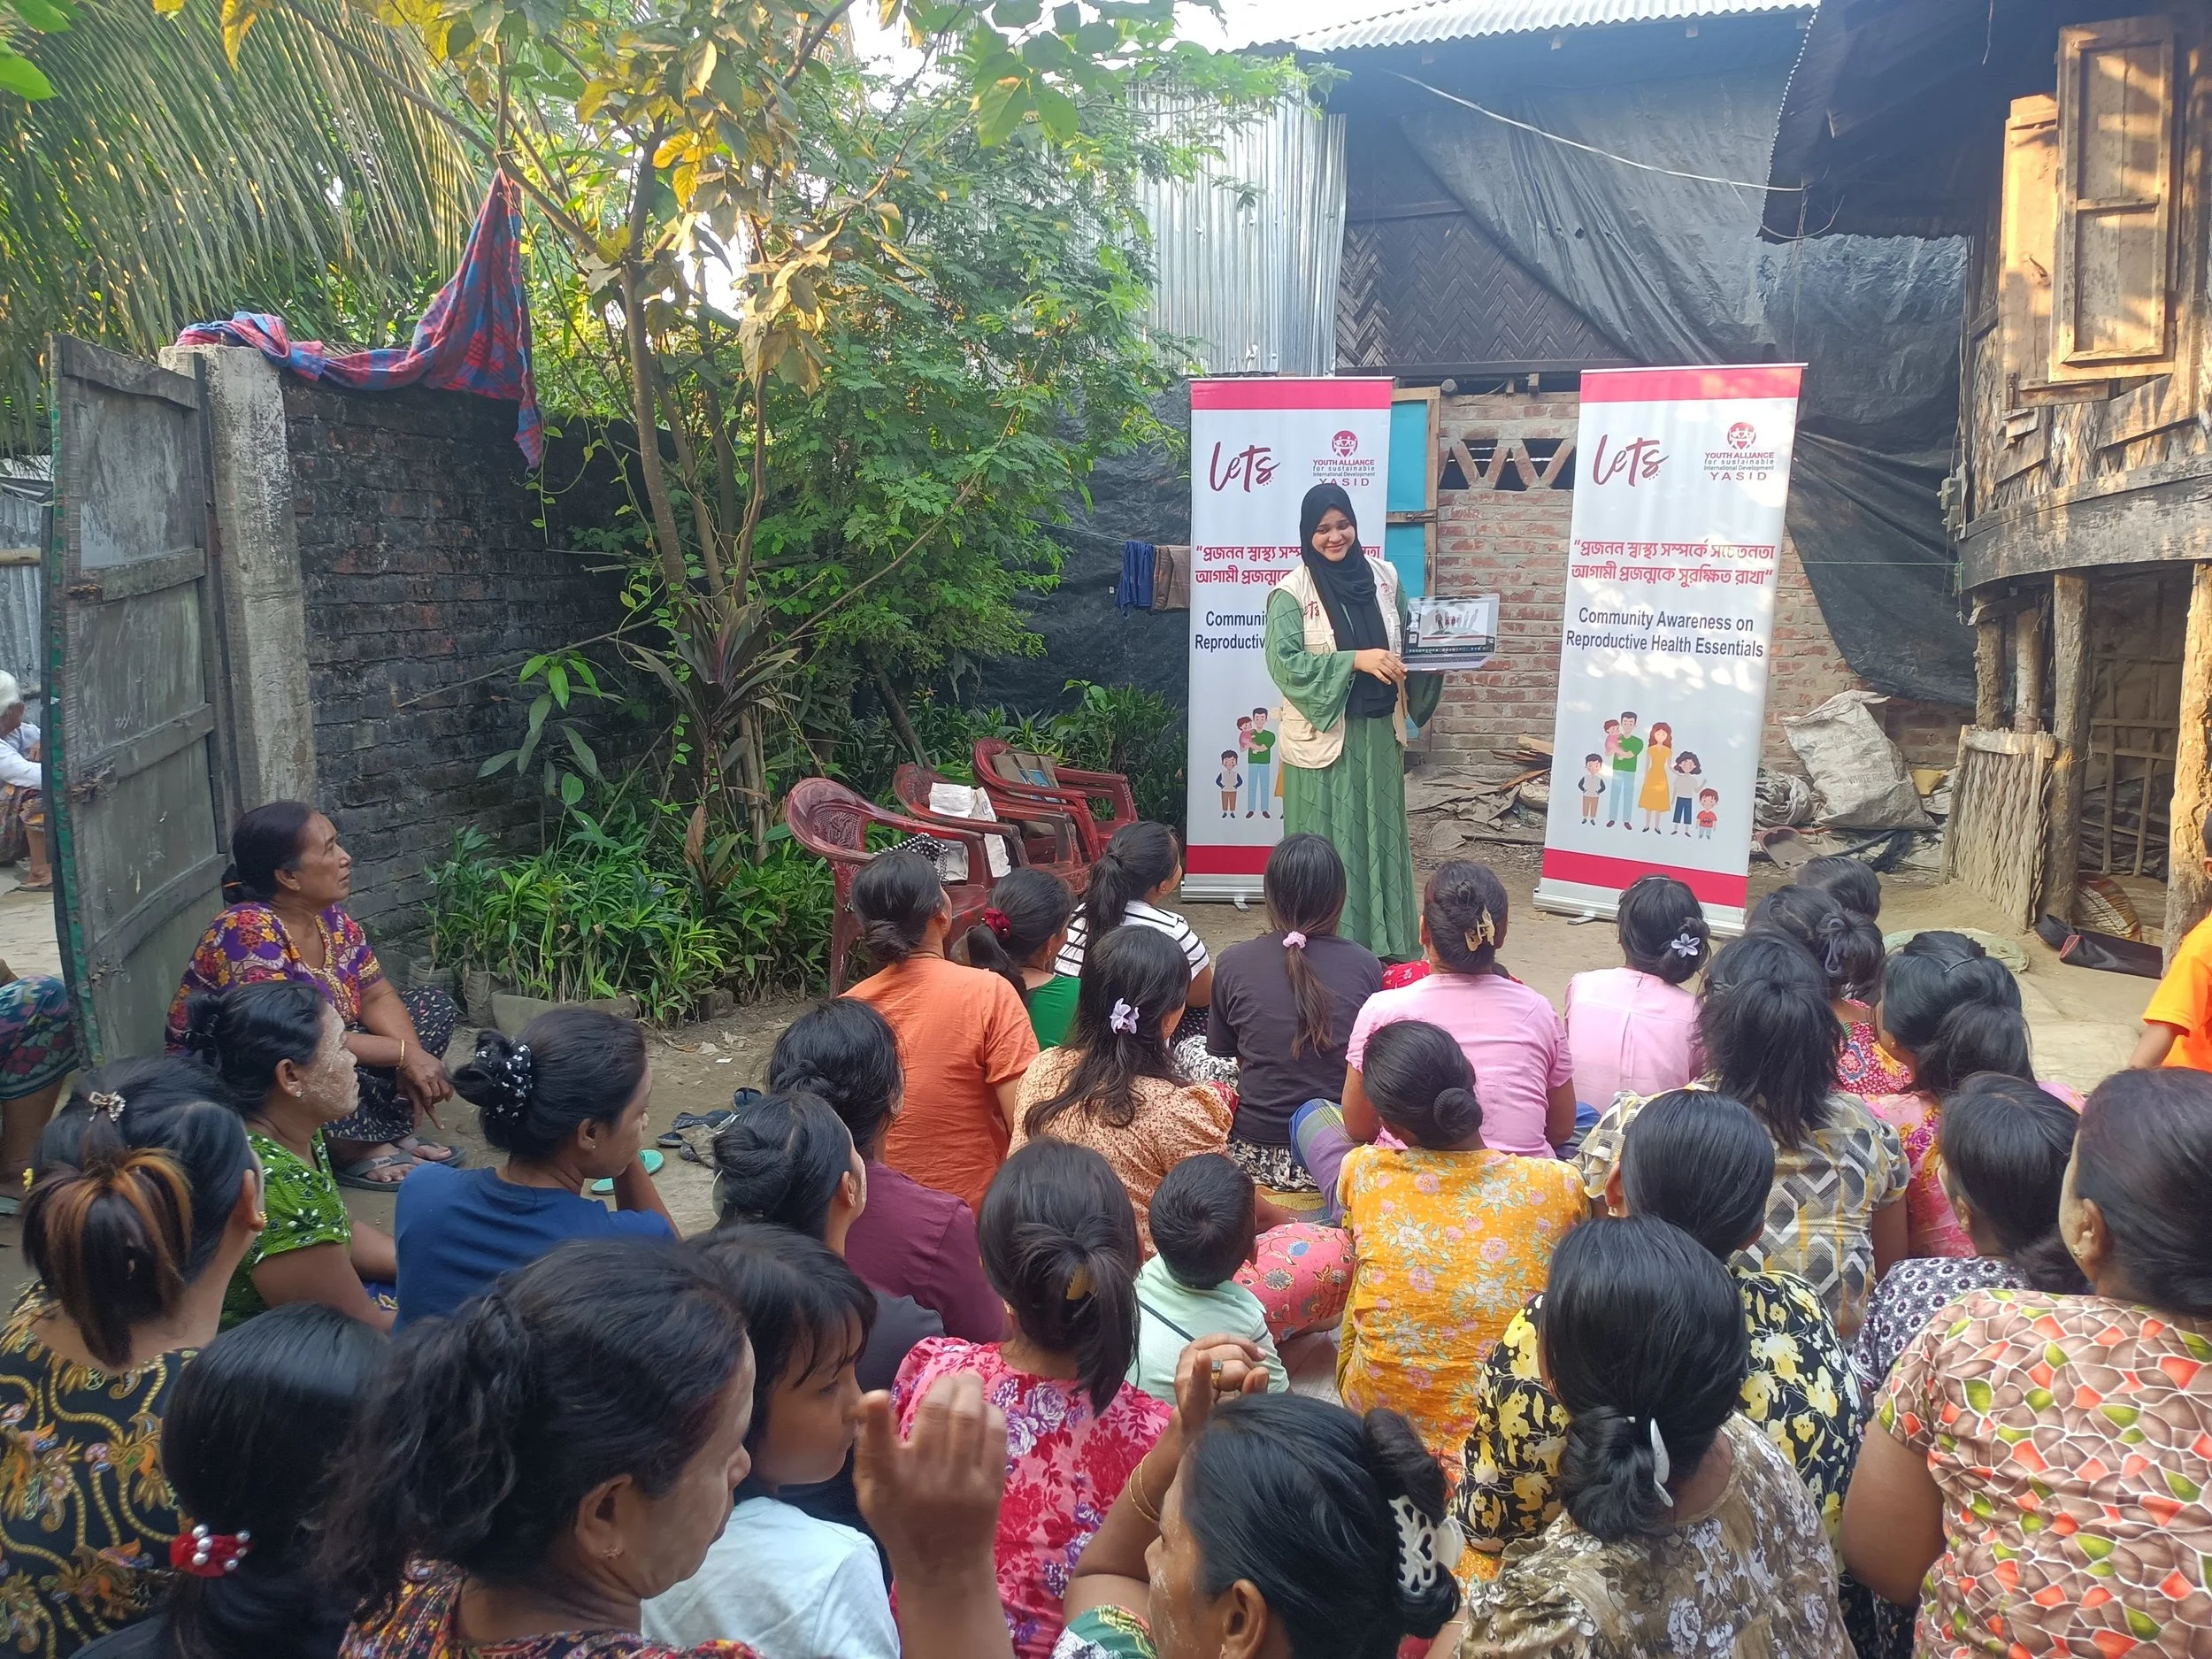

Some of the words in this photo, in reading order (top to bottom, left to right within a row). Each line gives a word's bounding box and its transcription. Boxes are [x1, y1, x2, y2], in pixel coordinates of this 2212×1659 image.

[1319, 478, 1370, 487] YASID
[1709, 472, 1768, 481] YASID
[1710, 544, 1776, 559] সচেতনতা
[1194, 565, 1240, 583] আগামী
[1571, 560, 1617, 580] আগামী
[1678, 563, 1733, 588] সুরক্ষিত
[1206, 611, 1268, 626] Communi
[1578, 607, 1654, 630] Community
[1656, 611, 1732, 631] Awareness
[1736, 618, 1754, 632] on
[1195, 634, 1265, 653] Reproductiv
[1566, 630, 1647, 650] Reproductive
[1651, 634, 1692, 653] Health
[1695, 637, 1763, 657] Essentials
